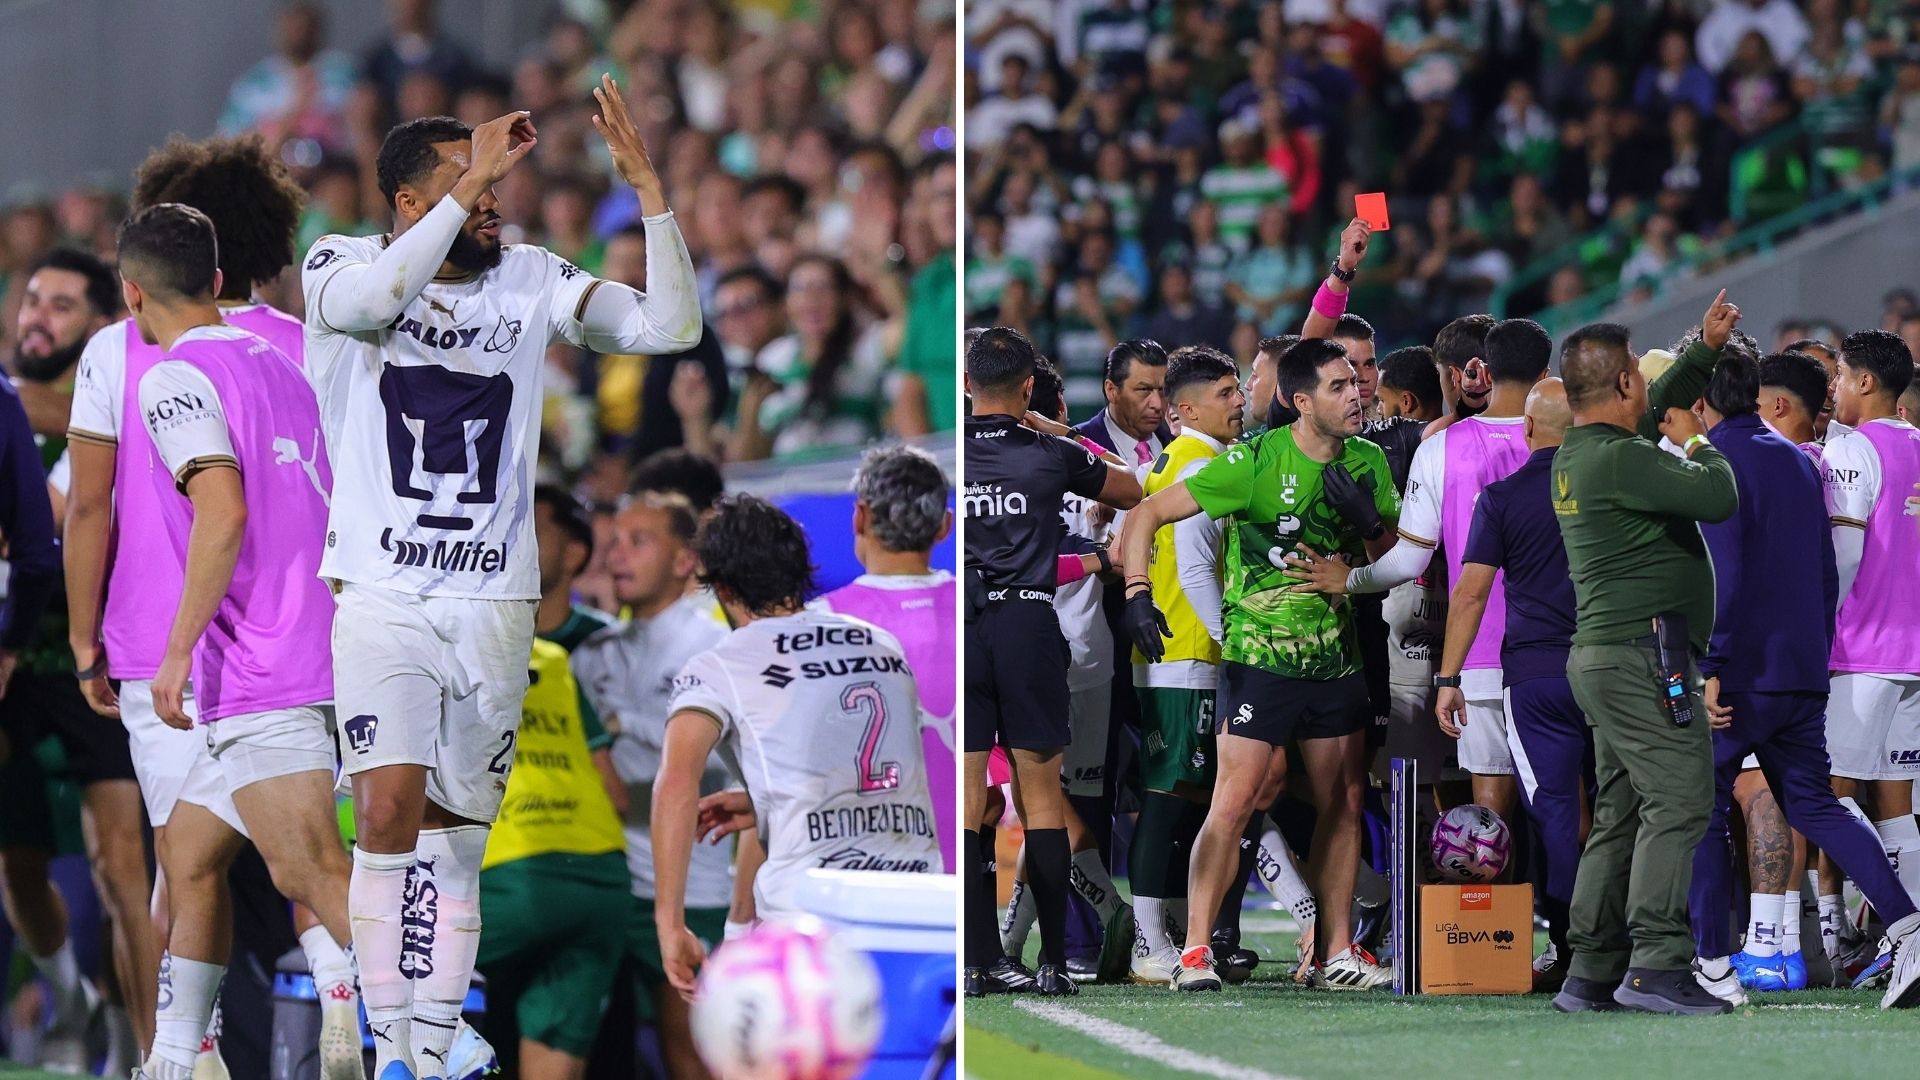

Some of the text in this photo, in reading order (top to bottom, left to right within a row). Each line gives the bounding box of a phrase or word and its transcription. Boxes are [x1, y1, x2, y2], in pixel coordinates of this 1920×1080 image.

[1826, 468, 1859, 483] GNP
[431, 540, 508, 573] Mifel
[839, 681, 900, 796] 2
[1461, 892, 1491, 901] amazon
[1435, 923, 1460, 933] LIGA
[1447, 930, 1491, 945] BBVA
